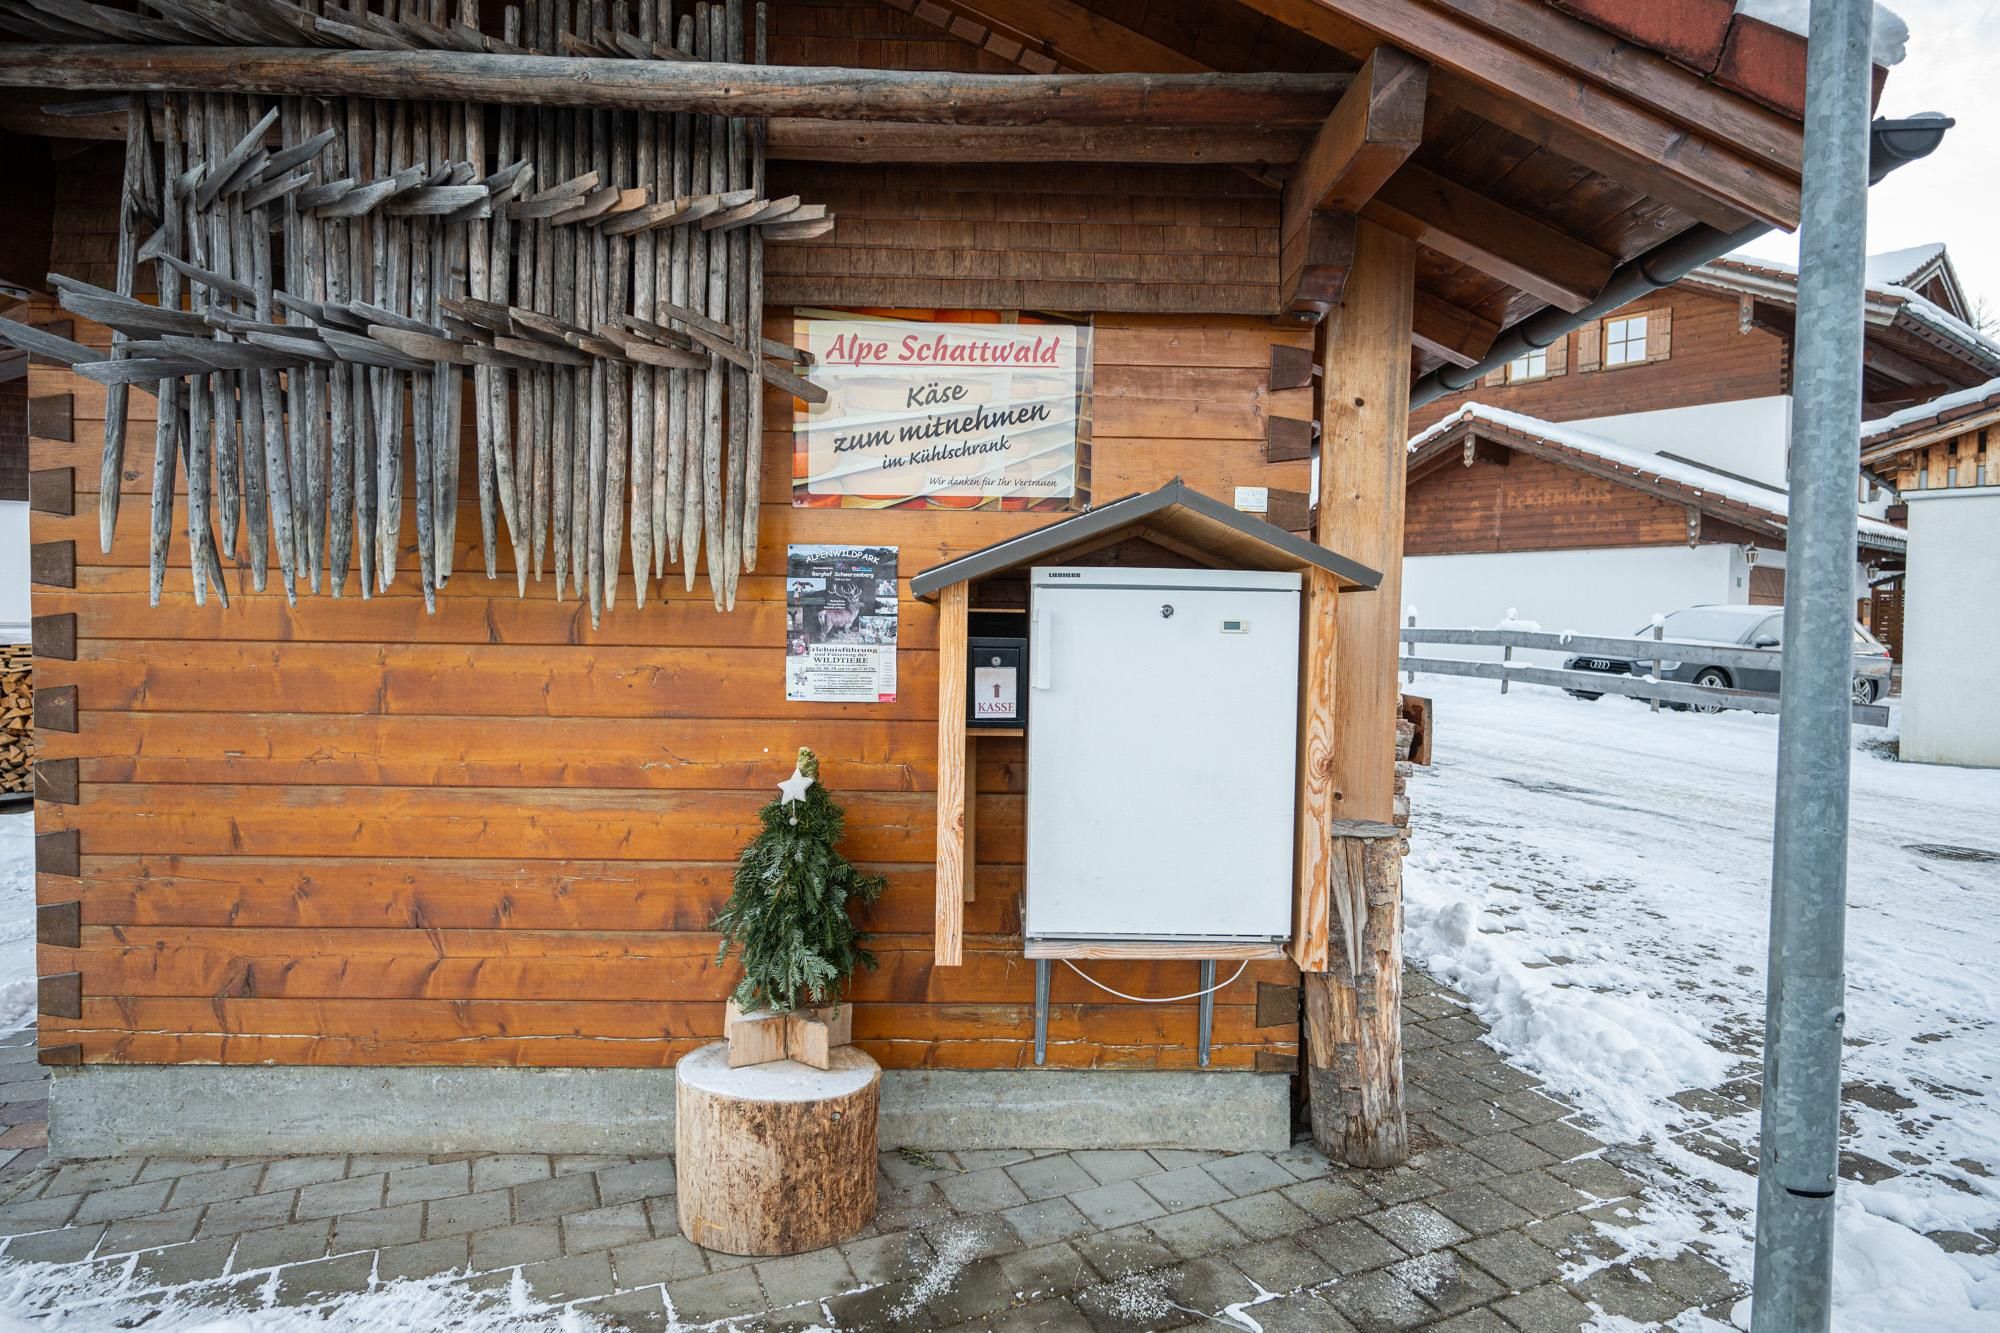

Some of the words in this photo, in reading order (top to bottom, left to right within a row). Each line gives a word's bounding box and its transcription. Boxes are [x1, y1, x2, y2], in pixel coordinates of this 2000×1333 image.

[825, 332, 888, 367] Alpe
[898, 334, 1060, 364] Schattwald
[906, 382, 968, 409] Käse
[833, 430, 894, 453] zum
[899, 404, 1051, 442] mitnehmen
[882, 454, 905, 470] im
[909, 435, 1012, 465] Kühlschrank
[929, 477, 946, 487] Wir
[947, 477, 981, 487] danken
[979, 477, 996, 491] für
[997, 477, 1012, 487] Ihr
[1014, 478, 1058, 488] Vertrauen
[806, 549, 880, 565] ALPENWILDPARK
[809, 646, 878, 654] rlebnisführung
[813, 656, 869, 664] WILDTIERE
[978, 702, 1015, 712] KASSE
